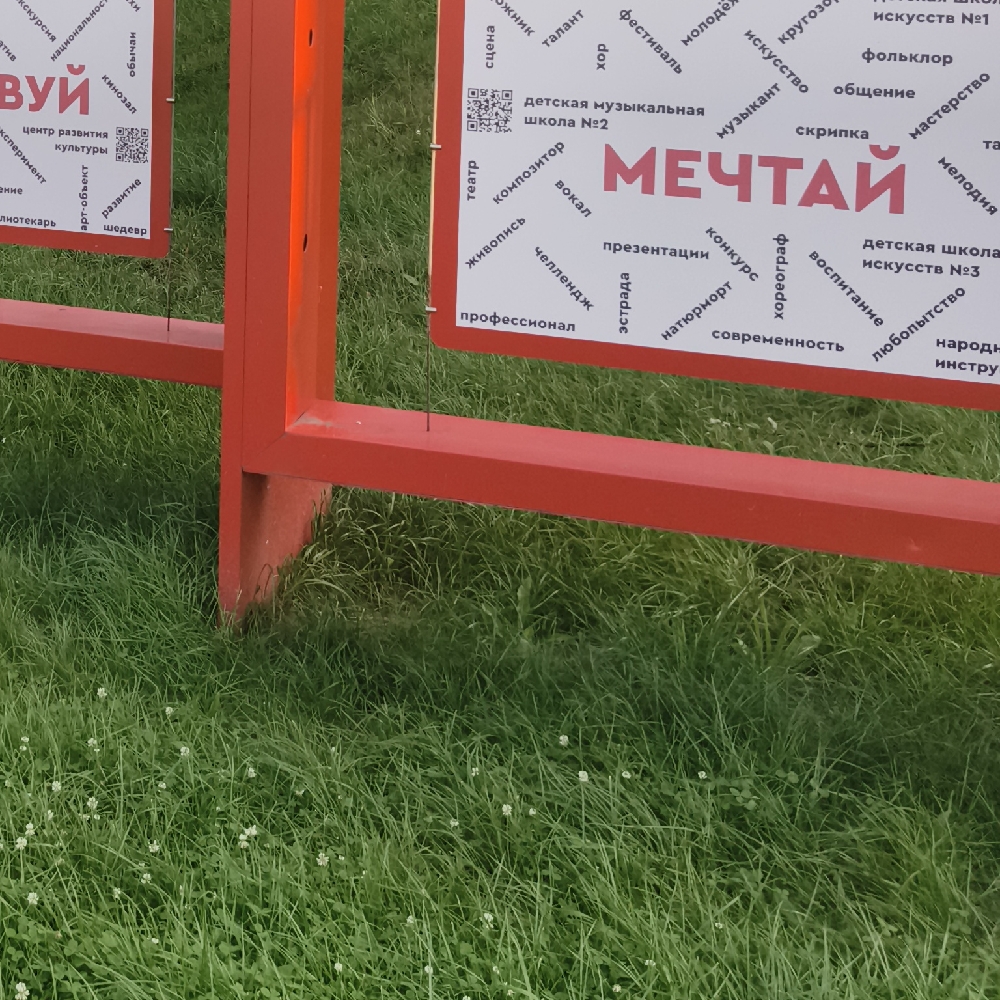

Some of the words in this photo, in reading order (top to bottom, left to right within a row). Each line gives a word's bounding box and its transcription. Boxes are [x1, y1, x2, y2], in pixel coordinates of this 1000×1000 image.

[542, 10, 584, 47] талант
[874, 12, 954, 26] искусств
[962, 12, 988, 25] №1
[486, 26, 496, 68] сцена
[597, 44, 609, 70] хор
[619, 9, 682, 74] фестиваль
[744, 30, 809, 93] искусство
[862, 48, 953, 66] фольклор
[101, 74, 137, 114] кинозал
[524, 97, 588, 109] детская
[594, 101, 704, 116] музыкальная
[833, 82, 916, 98] общение
[908, 73, 990, 140] мастерство
[524, 116, 576, 128] школа
[581, 117, 608, 130] №2
[716, 82, 780, 139] музыкант
[22, 126, 55, 137] центр
[58, 129, 108, 139] развития
[54, 144, 108, 156] культуры
[796, 126, 869, 140] скрипка
[467, 160, 480, 201] театр
[492, 142, 564, 204] композитор
[603, 143, 905, 215] МЕЧТАЙ
[938, 156, 998, 216] мелодия
[101, 179, 142, 220] развитие
[554, 180, 592, 218] вокал
[103, 224, 147, 236] шедевр
[465, 218, 526, 269] живопись
[862, 239, 935, 254] детская
[942, 244, 1000, 258] школа
[603, 242, 709, 260] презентации
[705, 227, 758, 282] конкурс
[863, 258, 943, 277] искусств
[950, 264, 980, 278] №3
[535, 246, 594, 311] челлендж
[772, 234, 789, 320] хореограф
[808, 250, 884, 326] воспитание
[460, 312, 575, 332] профессионал
[619, 272, 632, 334] эстрада
[661, 281, 732, 340] натюрморт
[712, 330, 844, 352] современность
[872, 288, 966, 362] любопытство
